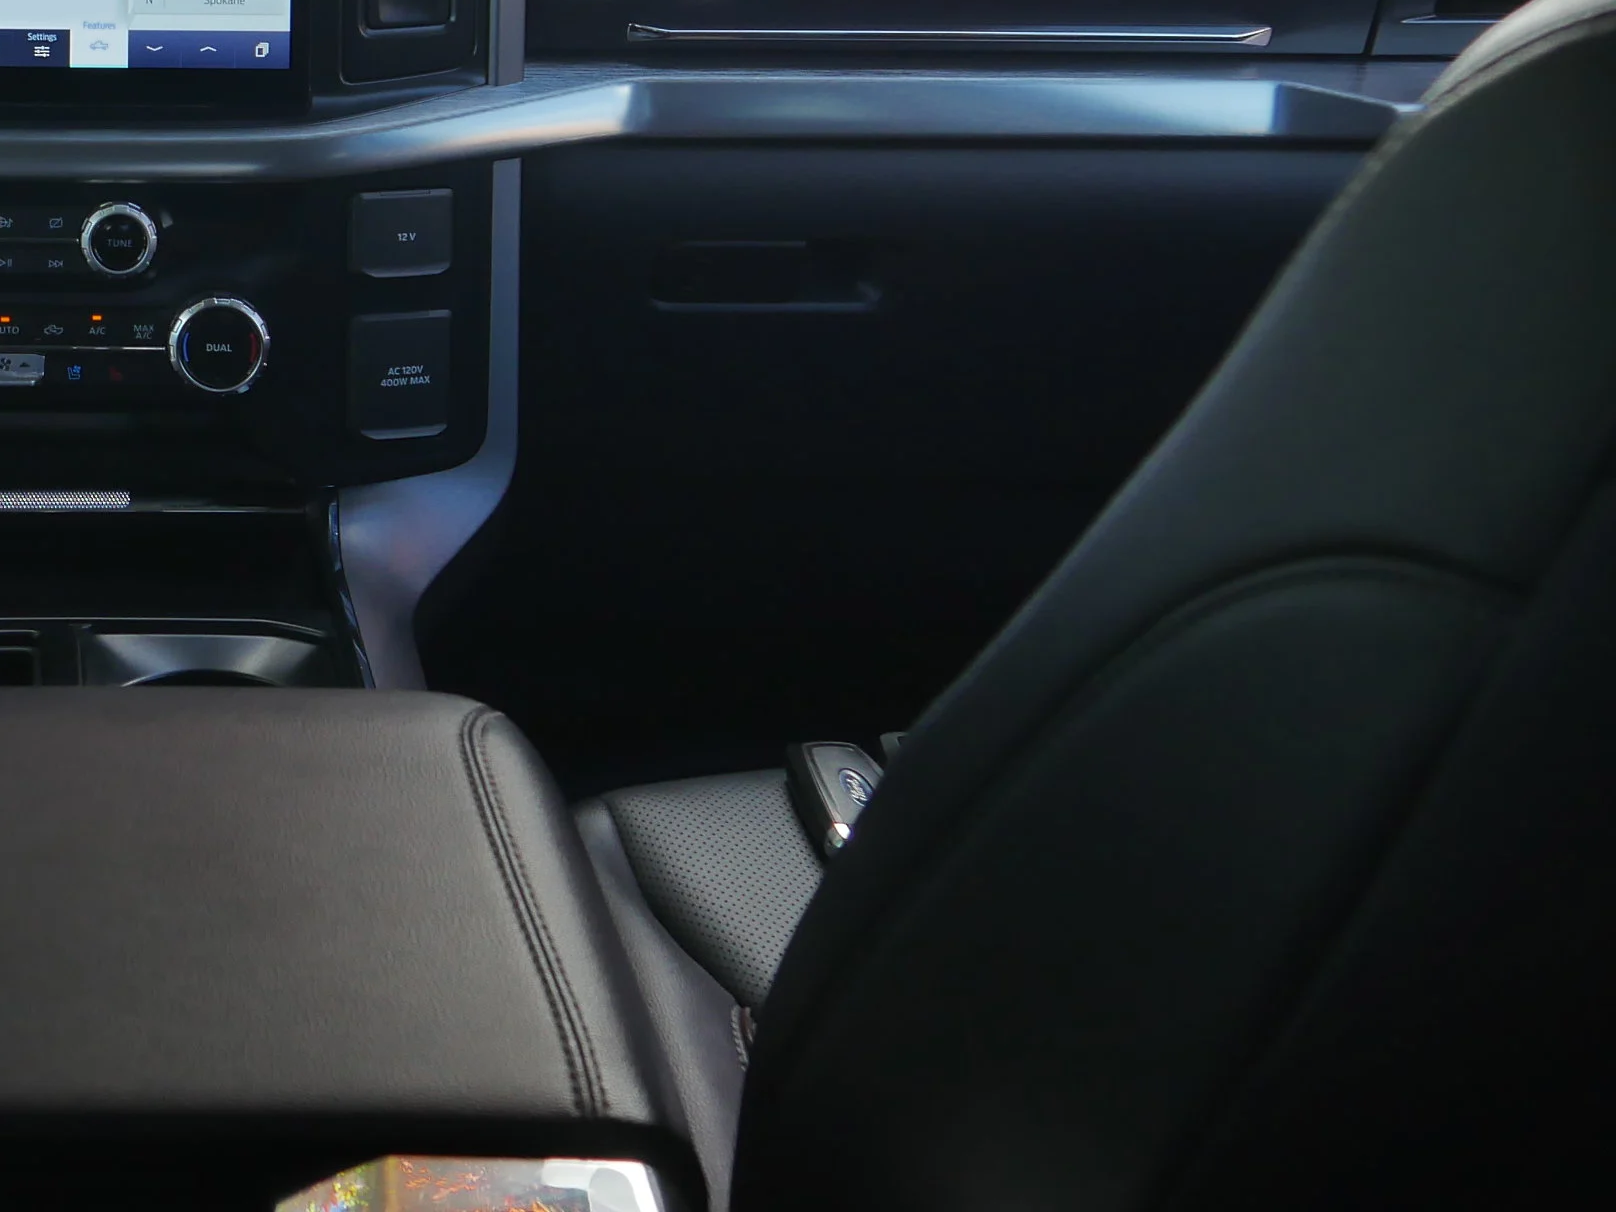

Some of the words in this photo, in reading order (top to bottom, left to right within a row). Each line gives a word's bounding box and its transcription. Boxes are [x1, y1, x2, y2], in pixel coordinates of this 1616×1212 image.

[83, 21, 116, 30] Features
[27, 32, 57, 42] Settings
[397, 233, 408, 242] 12
[409, 232, 417, 241] V
[107, 238, 133, 248] TUNE
[89, 326, 106, 335] A/C
[133, 324, 155, 332] MAX
[206, 343, 232, 352] DUAL
[387, 366, 401, 376] AC
[402, 365, 424, 375] 120V
[380, 377, 408, 387] 400W
[410, 375, 430, 385] MAX
